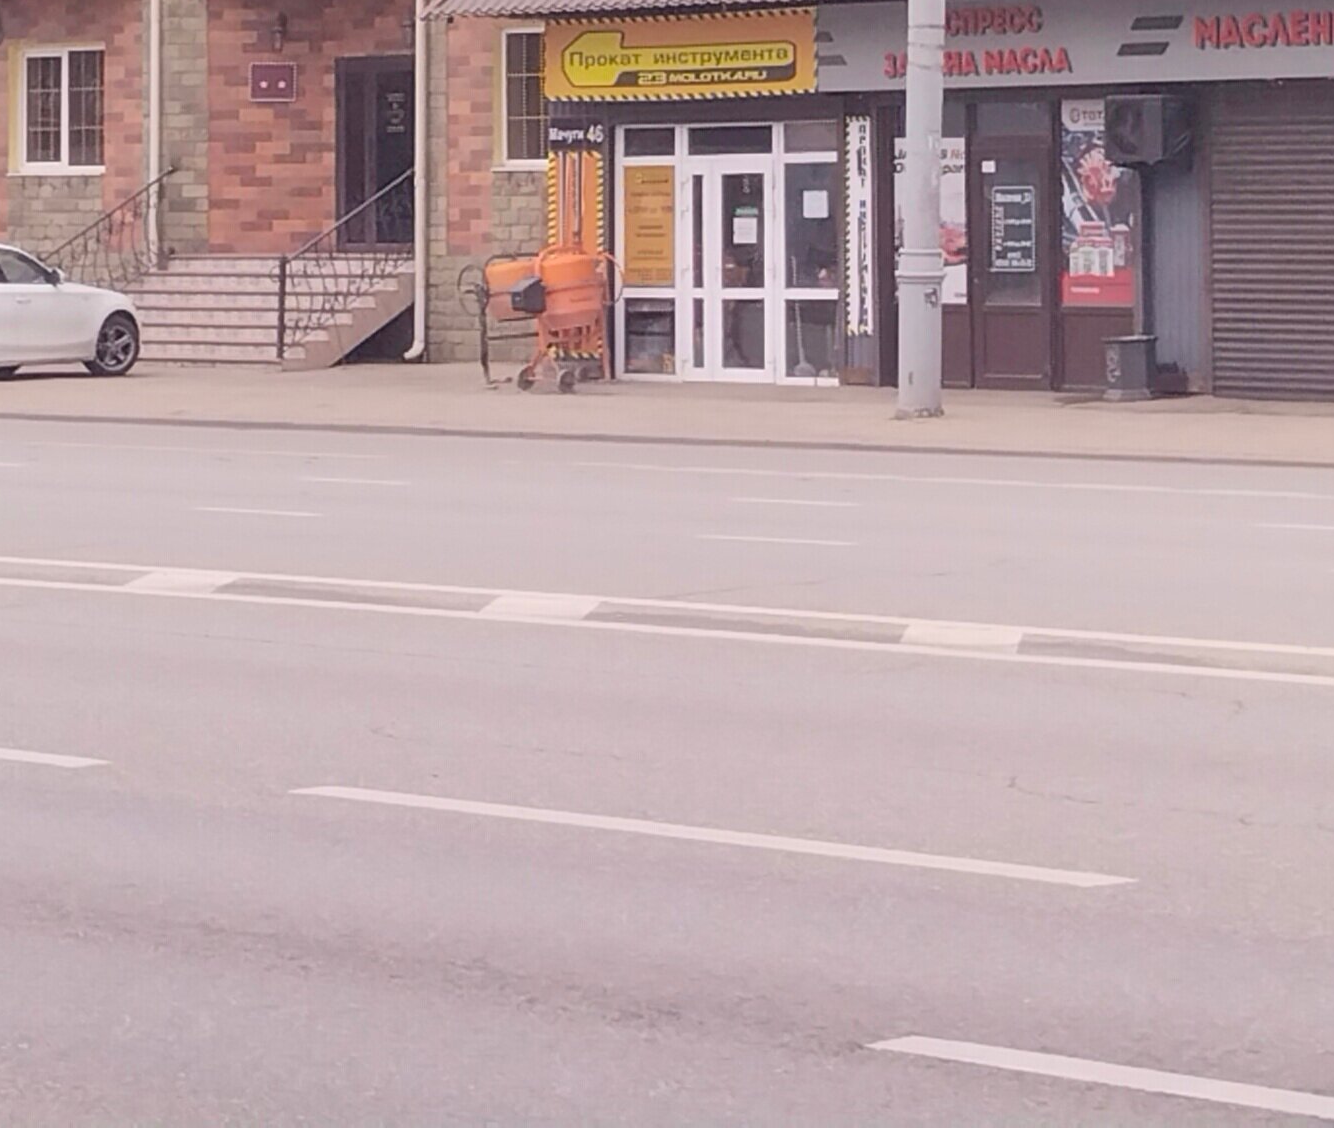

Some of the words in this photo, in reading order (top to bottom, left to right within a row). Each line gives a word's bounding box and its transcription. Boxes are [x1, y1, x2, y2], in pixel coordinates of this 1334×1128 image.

[944, 5, 1043, 36] СПРЕСС
[570, 51, 642, 69] Прокат
[653, 48, 789, 70] инструмента
[884, 50, 980, 79] ЗАНА
[983, 47, 1073, 76] МАСЛА
[587, 124, 604, 143] 46
